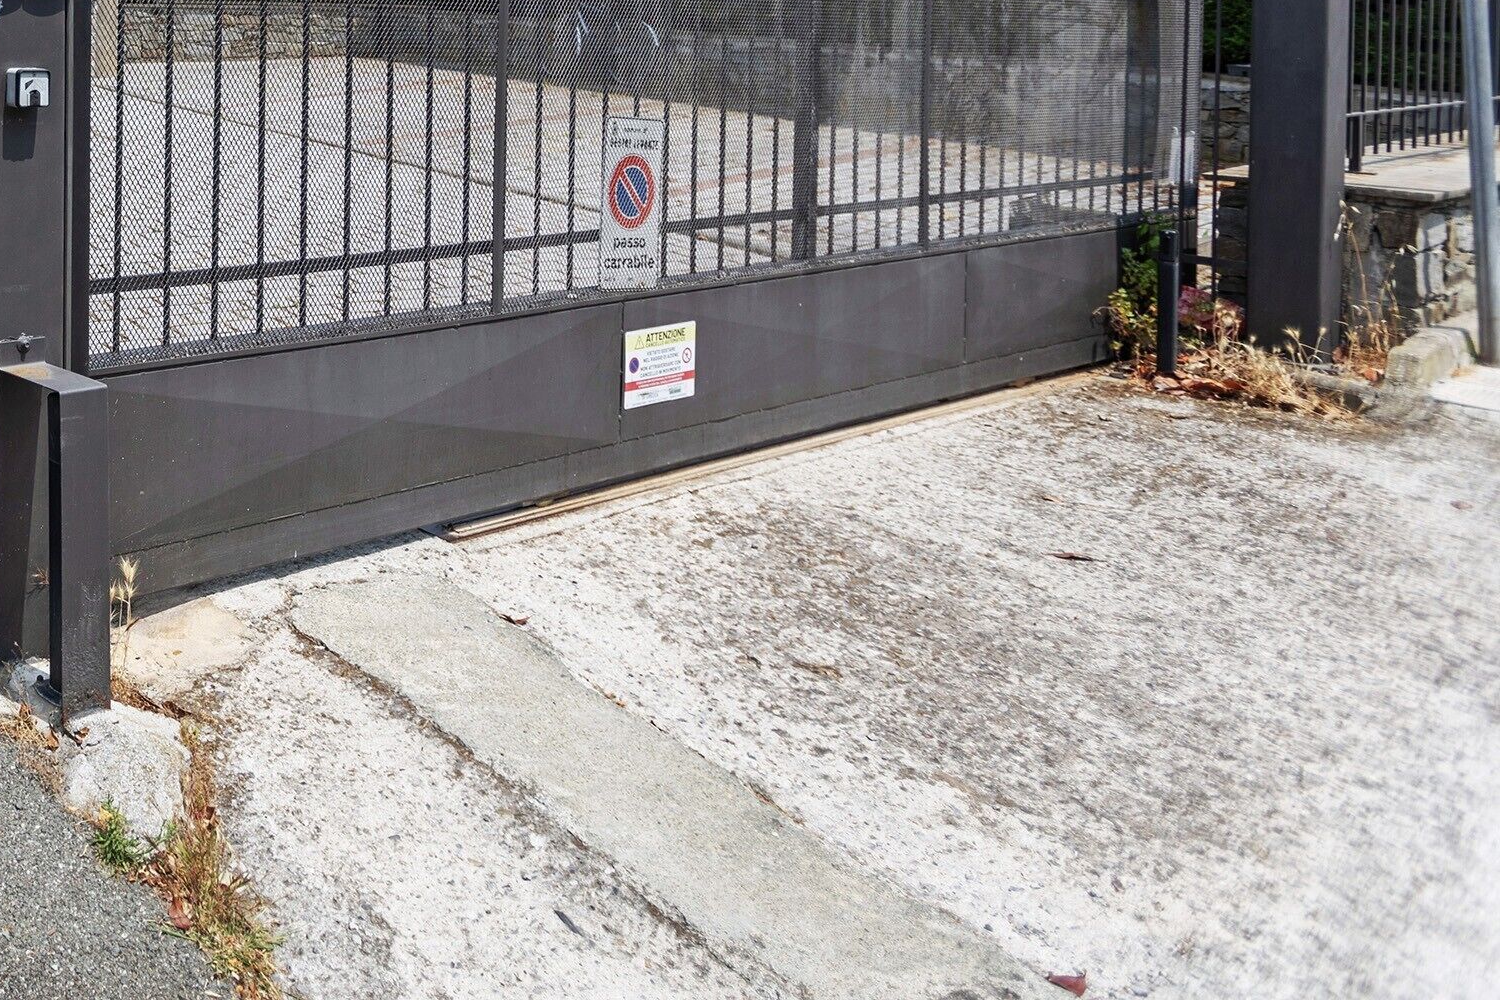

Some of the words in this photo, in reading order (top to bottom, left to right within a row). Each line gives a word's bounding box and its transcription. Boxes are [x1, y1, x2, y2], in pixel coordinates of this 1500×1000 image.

[613, 237, 646, 249] passo
[604, 255, 655, 269] carrabile
[646, 327, 686, 341] ATTENZIONE
